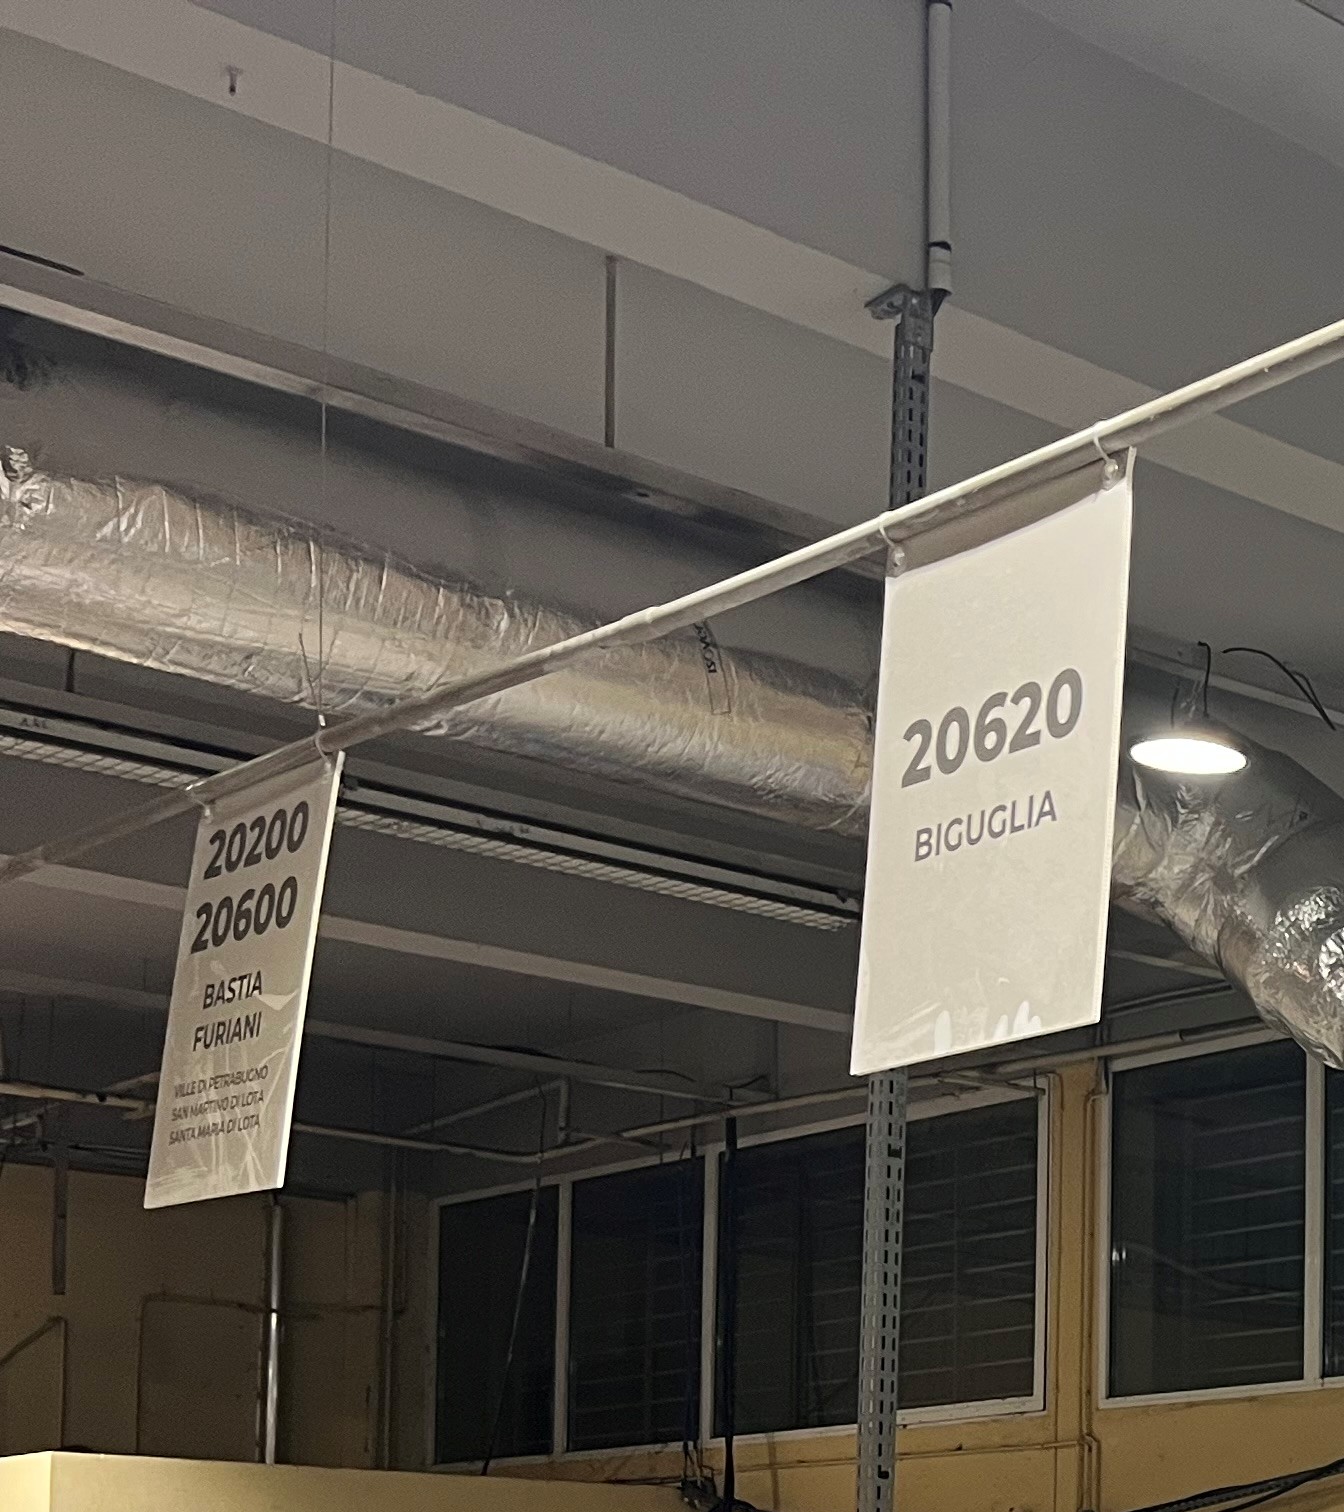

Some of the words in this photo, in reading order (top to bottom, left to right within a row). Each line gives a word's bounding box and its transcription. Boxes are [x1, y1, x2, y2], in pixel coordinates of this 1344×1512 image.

[902, 667, 1083, 788] 20620
[203, 801, 309, 881] 20200
[914, 789, 1057, 863] BIGUGLIA
[190, 876, 299, 954] 20600
[202, 970, 263, 1010] BASTIA
[193, 1011, 263, 1053] FURIANI
[168, 1127, 196, 1146] SANTA
[238, 1113, 261, 1132] LOTA
[171, 1106, 189, 1121] SAN
[241, 1089, 265, 1107] LOTA
